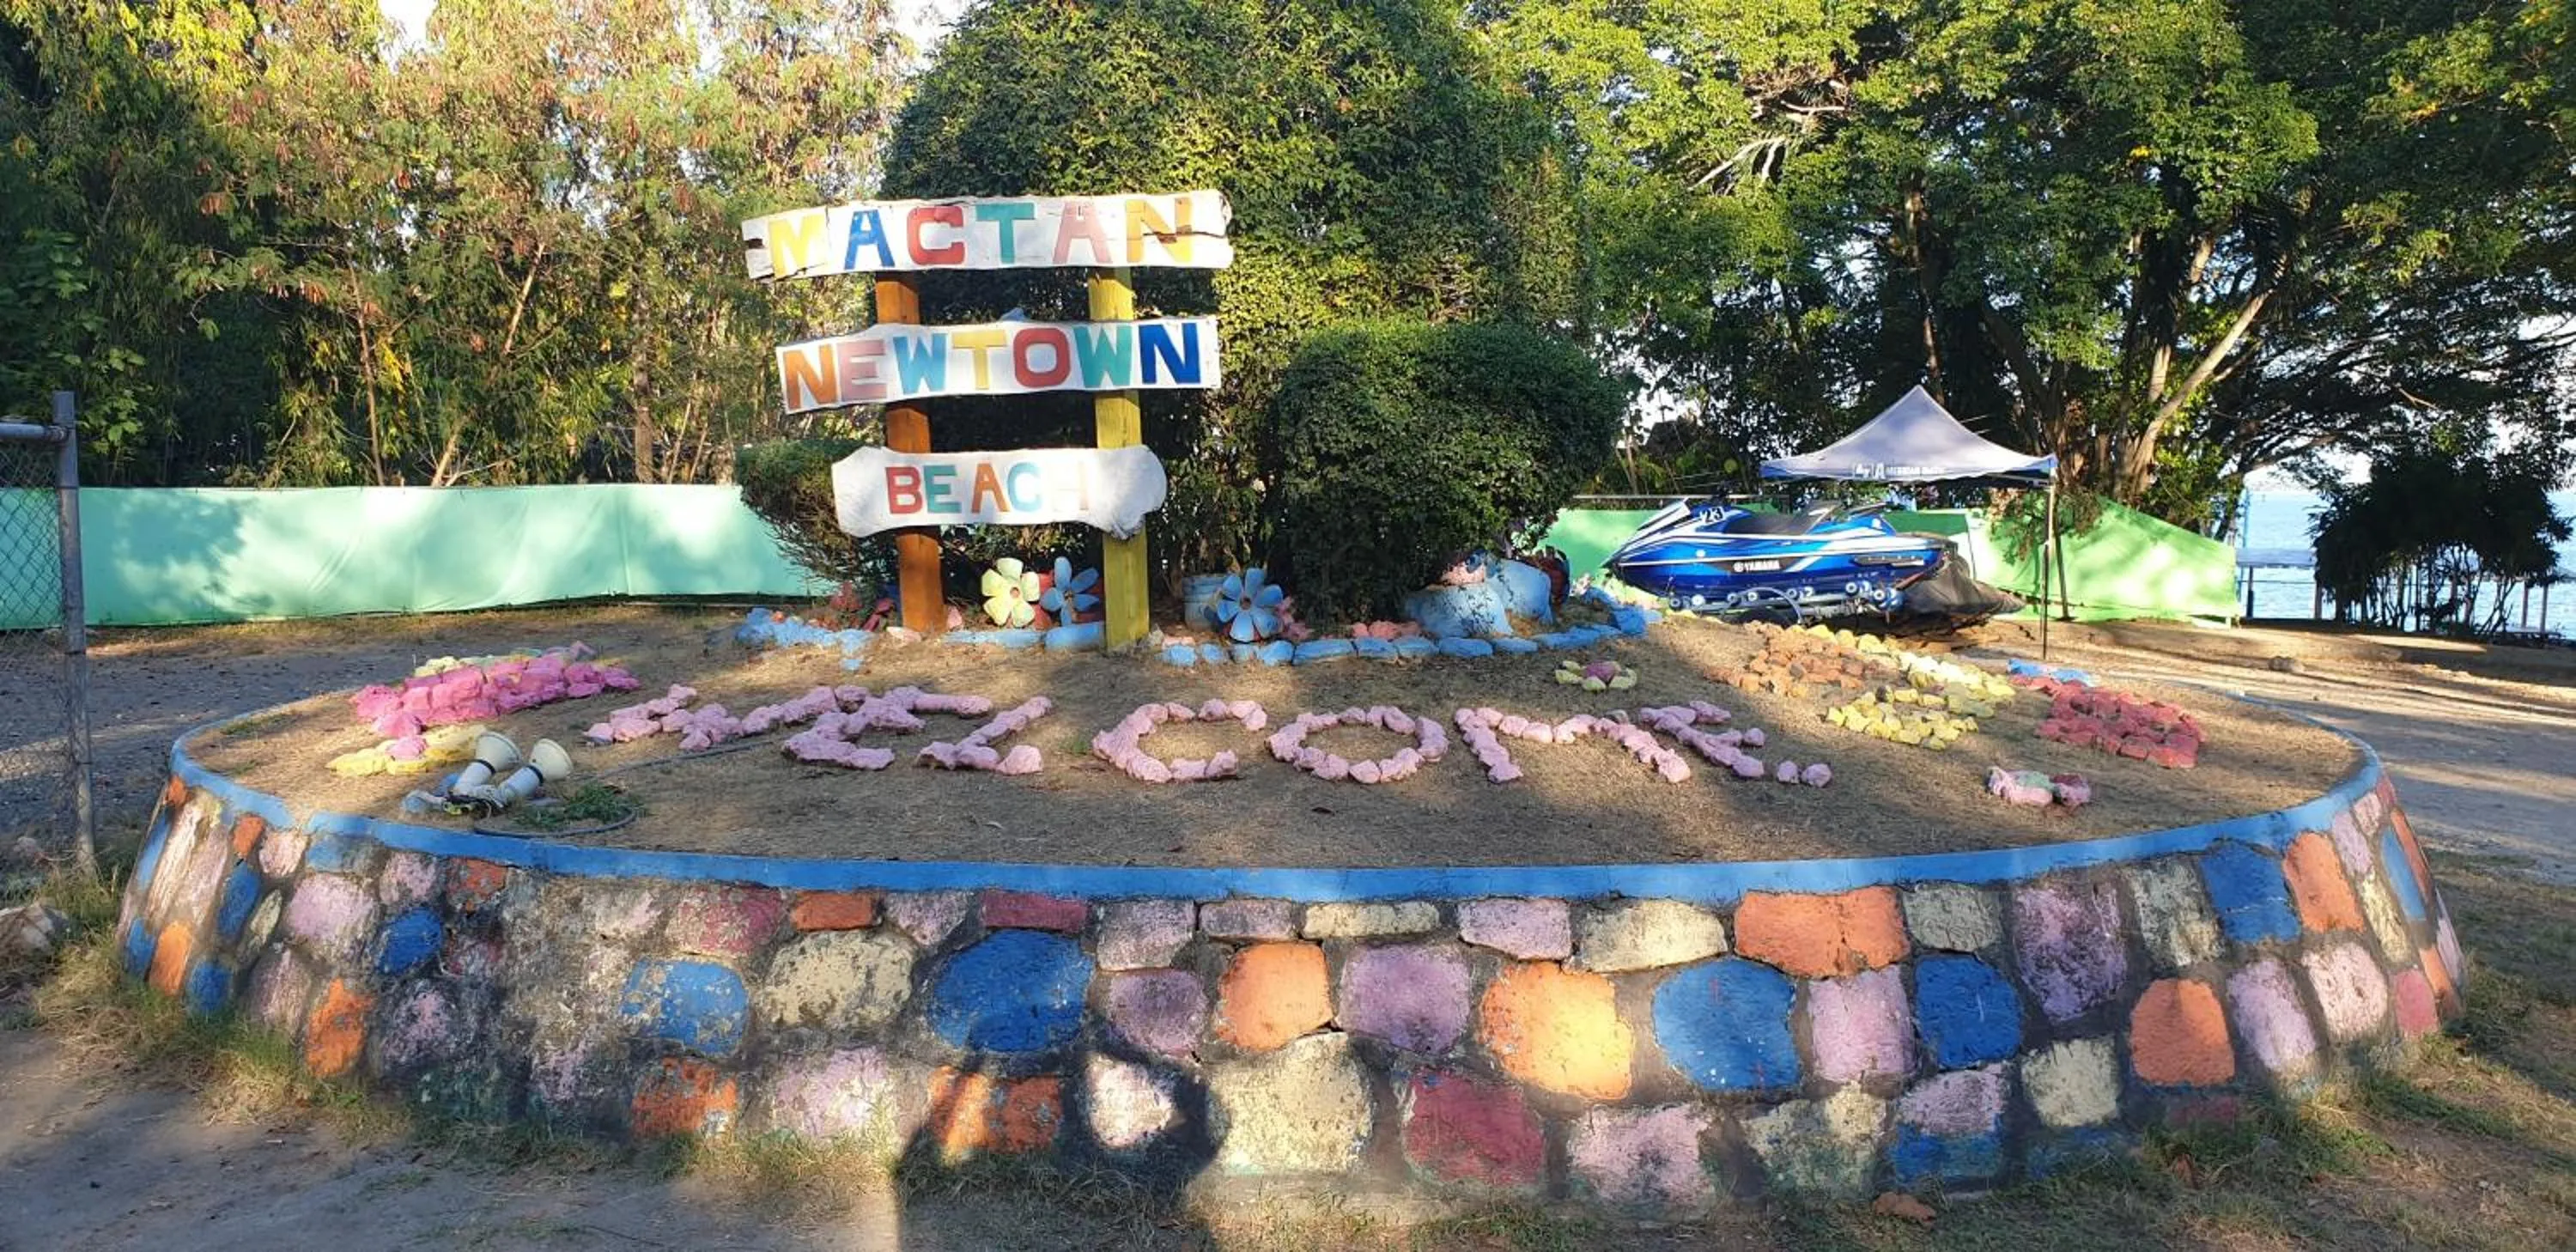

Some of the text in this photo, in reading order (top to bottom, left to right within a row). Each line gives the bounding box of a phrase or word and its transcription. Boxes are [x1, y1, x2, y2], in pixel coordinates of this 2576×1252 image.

[767, 198, 1193, 277] MACTAN
[782, 322, 1201, 410] NEWTOWN
[884, 460, 1091, 515] BEACH
[1700, 507, 1724, 523] 23
[1744, 560, 1780, 571] YAMAHA
